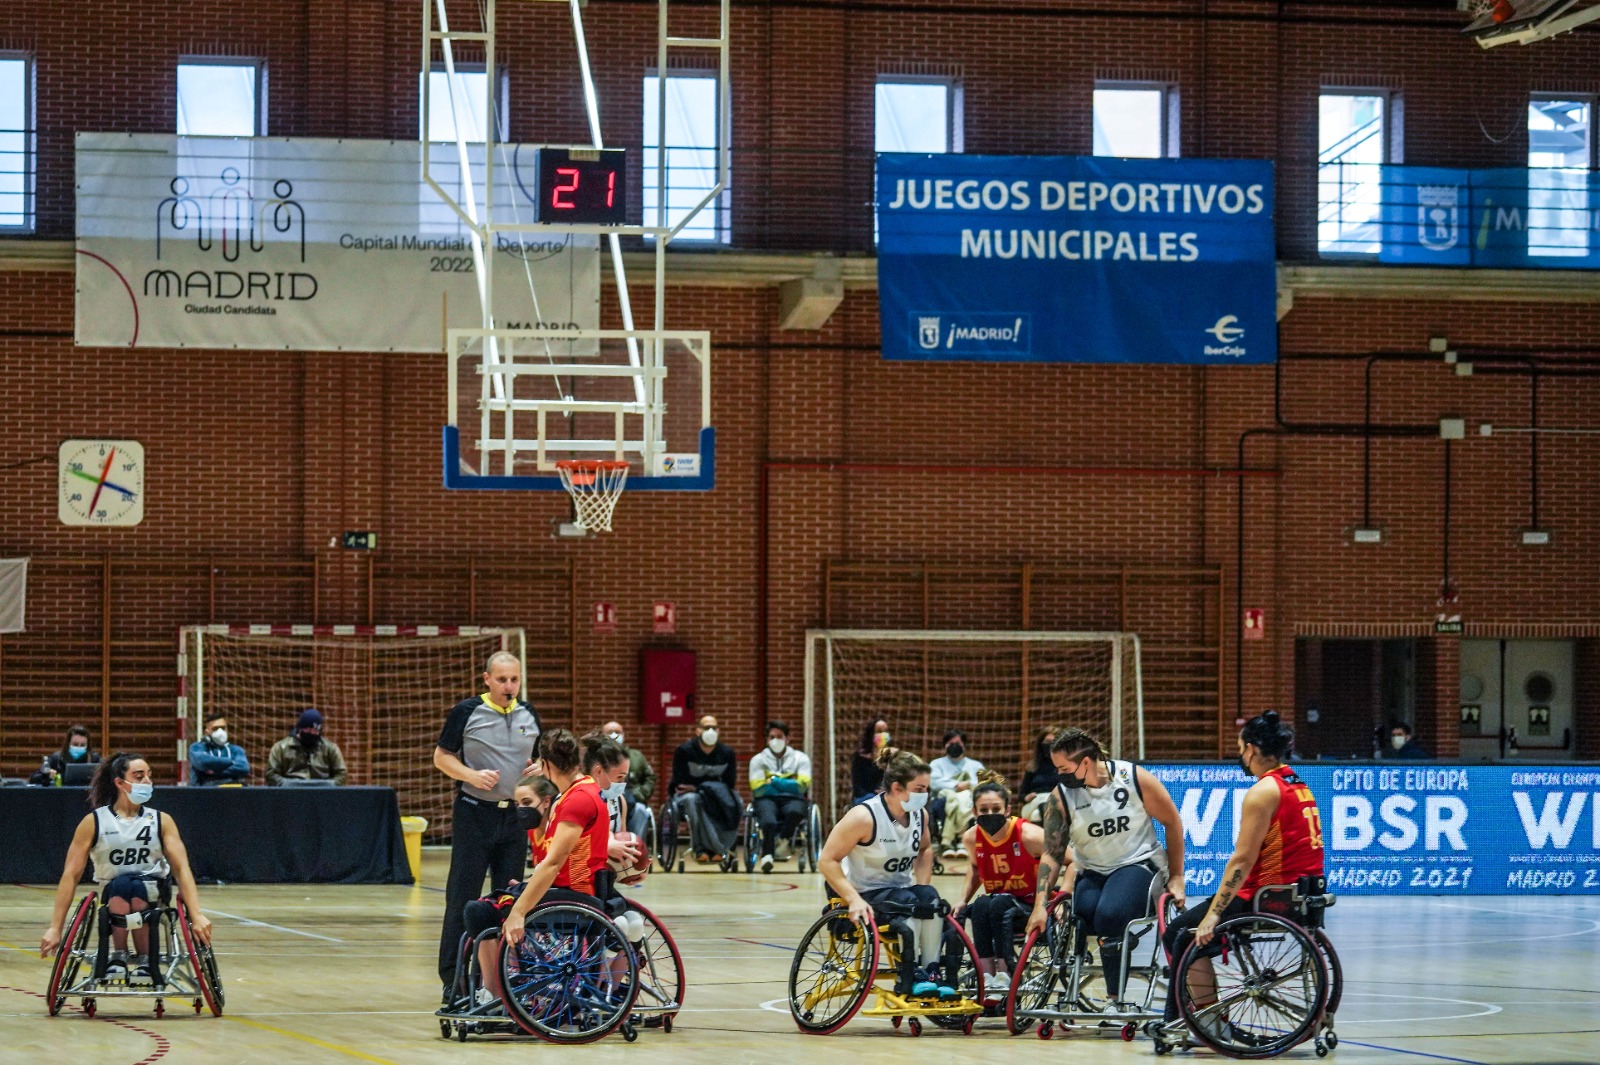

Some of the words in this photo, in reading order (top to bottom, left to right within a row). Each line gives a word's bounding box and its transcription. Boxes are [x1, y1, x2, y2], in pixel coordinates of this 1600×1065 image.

[552, 168, 615, 208] 21
[889, 179, 1031, 210] JUEGOS
[1040, 181, 1264, 214] DEPORTIVOS
[339, 233, 398, 251] Capital
[401, 236, 465, 251] Mundial
[498, 237, 564, 256] Deporte
[961, 229, 1199, 262] MUNICIPALES
[430, 256, 474, 273] 2022
[144, 270, 318, 301] MADRID
[184, 304, 222, 315] Ciudad
[224, 305, 277, 316] Candidata
[946, 317, 1022, 349] ¡MADRID!
[99, 448, 105, 456] 0
[72, 463, 83, 471] 50
[72, 493, 82, 501] 40
[122, 493, 132, 501] 20
[96, 510, 107, 518] 30
[1332, 769, 1374, 790] CPTO
[1379, 769, 1400, 790] DE
[1405, 769, 1469, 790] EUROPA
[1511, 773, 1561, 786] EUROPEAN
[1113, 788, 1129, 810] 9
[1087, 815, 1131, 838] GBR
[1331, 794, 1469, 850] BSR
[135, 825, 152, 845] 4
[912, 829, 920, 852] 8
[109, 848, 151, 866] GBR
[990, 853, 1010, 874] 15
[983, 873, 1029, 891] SPAÑA
[1327, 867, 1401, 888] MADRID
[1410, 866, 1473, 888] 2021
[1507, 869, 1577, 888] MADRID
